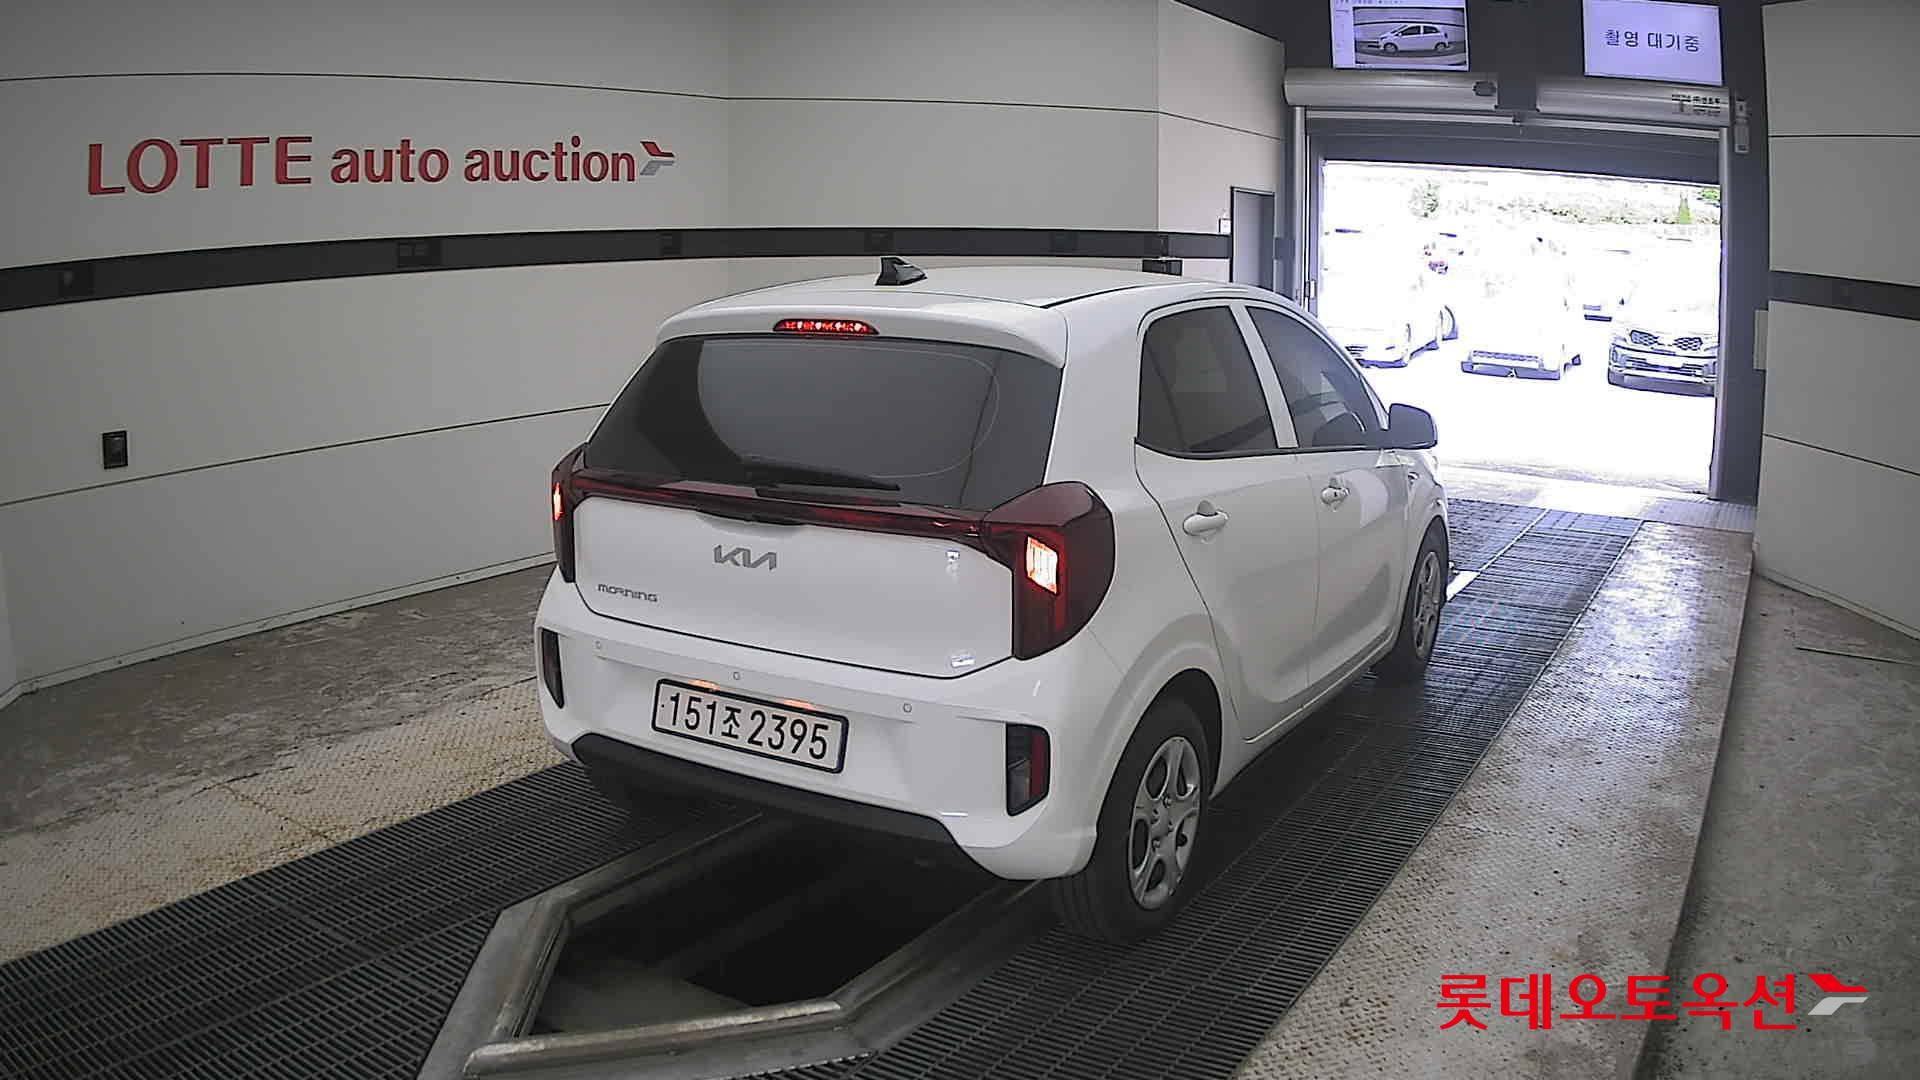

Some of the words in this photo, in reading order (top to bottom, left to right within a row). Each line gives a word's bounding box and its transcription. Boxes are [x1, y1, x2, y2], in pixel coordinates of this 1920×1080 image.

[1647, 32, 1700, 53] 대기중
[88, 136, 313, 195] LOTTE
[331, 139, 449, 184] auto
[464, 136, 637, 183] auction
[713, 544, 777, 571] KIA
